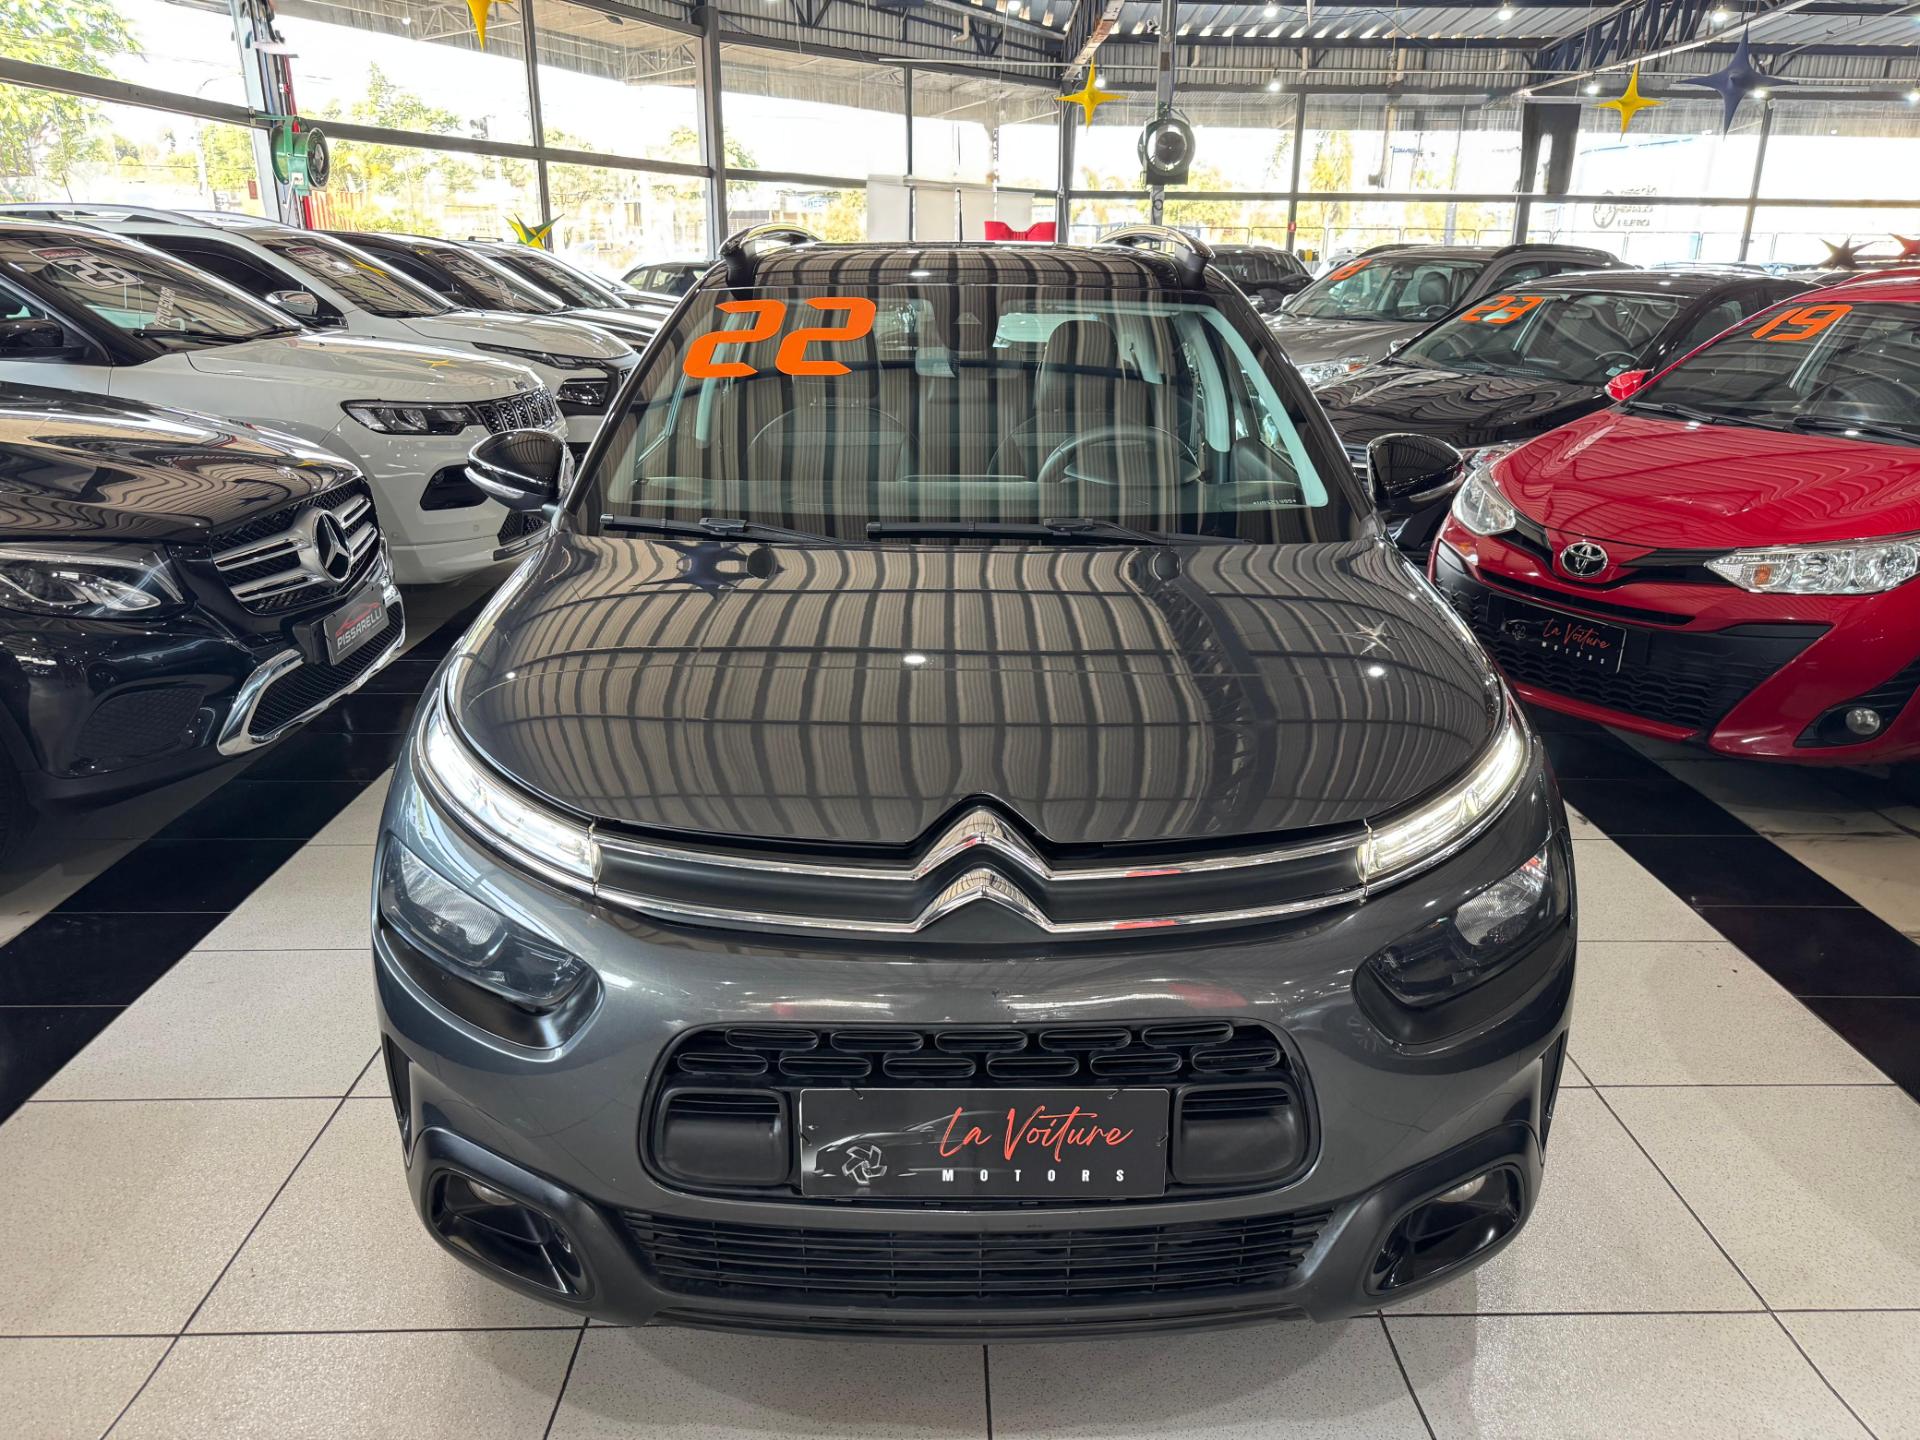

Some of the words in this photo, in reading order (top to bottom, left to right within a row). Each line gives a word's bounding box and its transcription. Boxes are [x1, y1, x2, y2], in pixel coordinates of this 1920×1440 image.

[56, 257, 140, 286] 26
[1460, 294, 1546, 325] 23
[1752, 304, 1853, 341] 19
[682, 297, 877, 378] 22
[337, 608, 382, 649] PISSARELLI
[1542, 618, 1561, 637] La
[1563, 624, 1610, 650] Voiture
[939, 1106, 992, 1157] La
[1003, 1105, 1134, 1163] Voiture
[942, 1168, 1125, 1182] MOTORS
